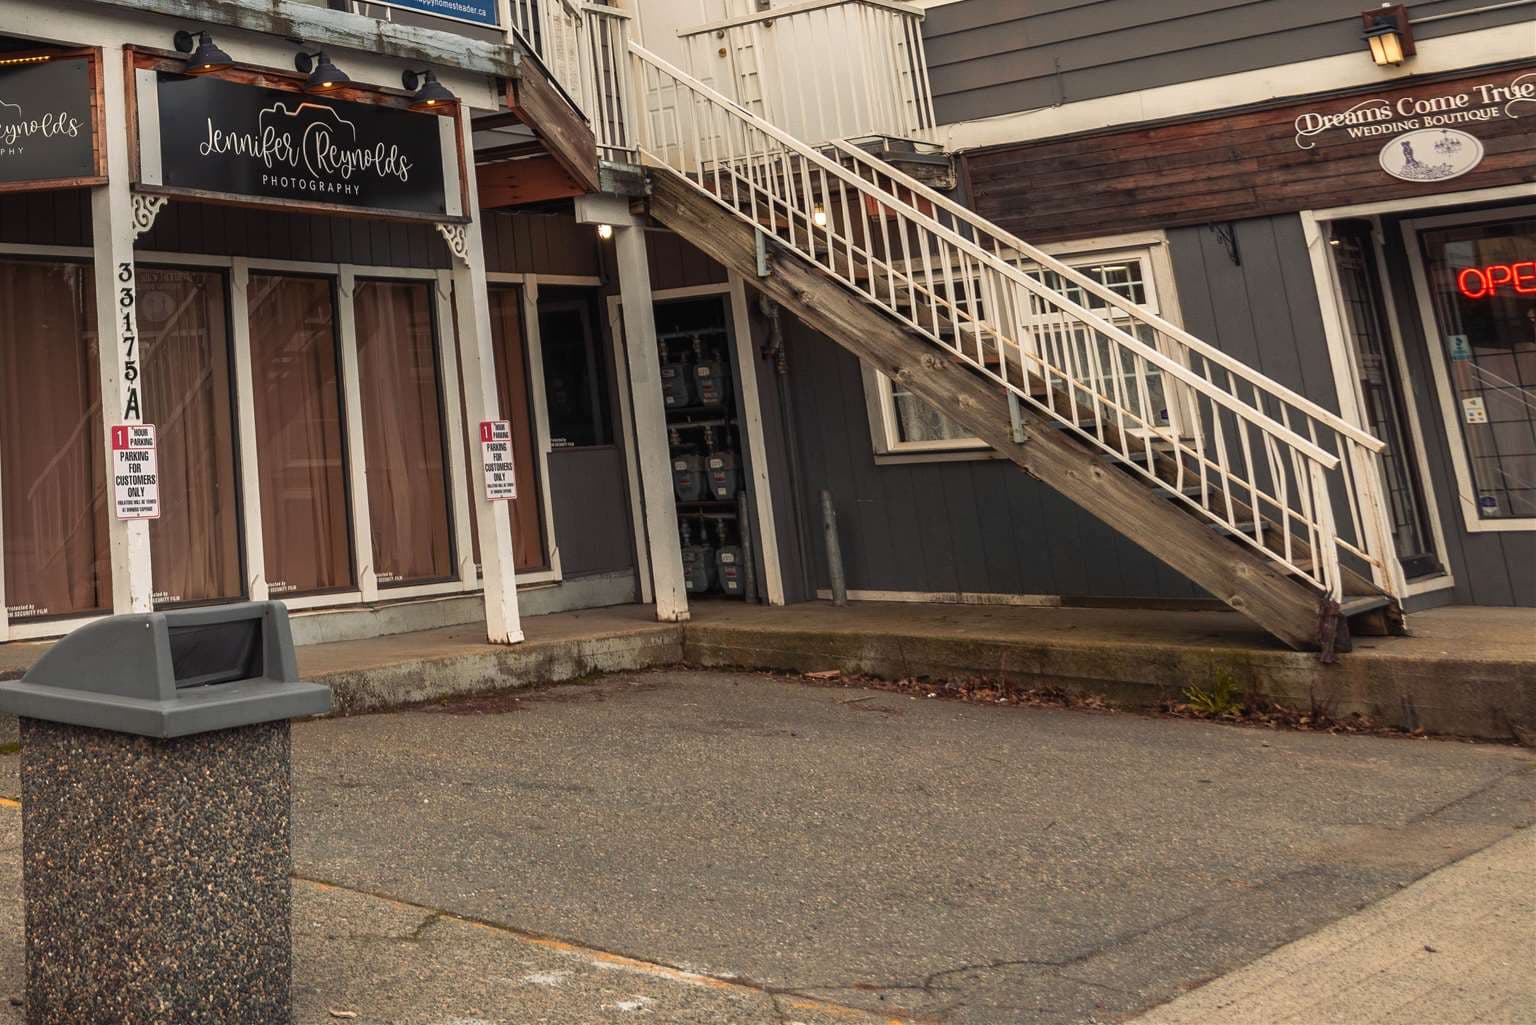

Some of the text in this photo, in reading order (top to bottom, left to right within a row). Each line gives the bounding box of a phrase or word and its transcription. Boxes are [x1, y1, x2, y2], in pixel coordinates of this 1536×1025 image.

[1296, 79, 1536, 138] Dreams Come True
[1346, 107, 1500, 139] WEDDING BOUTIQUE
[199, 117, 413, 182] Jennifer Reynolds
[262, 175, 360, 195] PHOTOGRAPHY
[1457, 261, 1536, 299] OPE
[117, 430, 123, 446] 1
[130, 438, 153, 446] PARKING
[120, 451, 149, 462] PARKING
[128, 463, 142, 473] FOR
[115, 474, 156, 486] CUSTOMERS
[127, 487, 145, 497] ONLY
